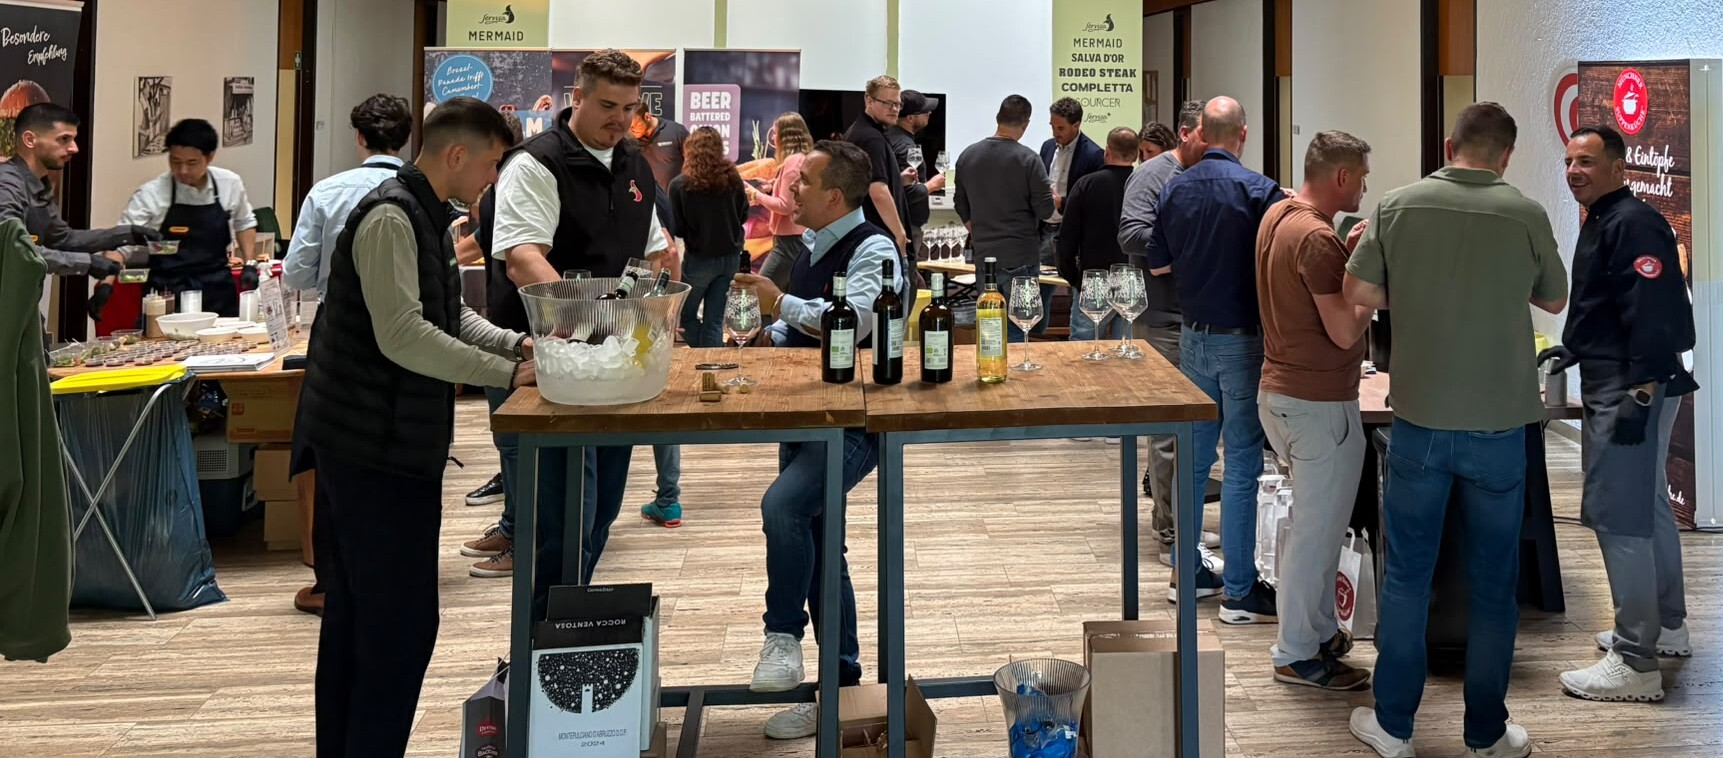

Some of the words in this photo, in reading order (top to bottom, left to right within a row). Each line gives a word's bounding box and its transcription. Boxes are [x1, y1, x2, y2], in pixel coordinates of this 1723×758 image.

[0, 24, 51, 48] Besondere
[468, 30, 524, 42] MERMAID
[1073, 38, 1123, 49] MERMAID
[27, 44, 68, 67] Empfehlung
[1071, 53, 1101, 63] SALVA
[1103, 53, 1125, 63] D'OR
[1058, 68, 1097, 78] RODEO
[1099, 68, 1137, 78] STEAK
[438, 78, 466, 87] Panade
[1061, 82, 1134, 93] COMPLETTA
[690, 91, 732, 110] BEER
[1076, 98, 1121, 108] SOURCER
[690, 112, 731, 122] BATTERED
[1625, 146, 1633, 164] &
[1634, 144, 1675, 178] Eintöpfe
[555, 621, 594, 630] VENTOSA
[596, 618, 627, 627] ROCCA
[580, 740, 606, 748] 2024
